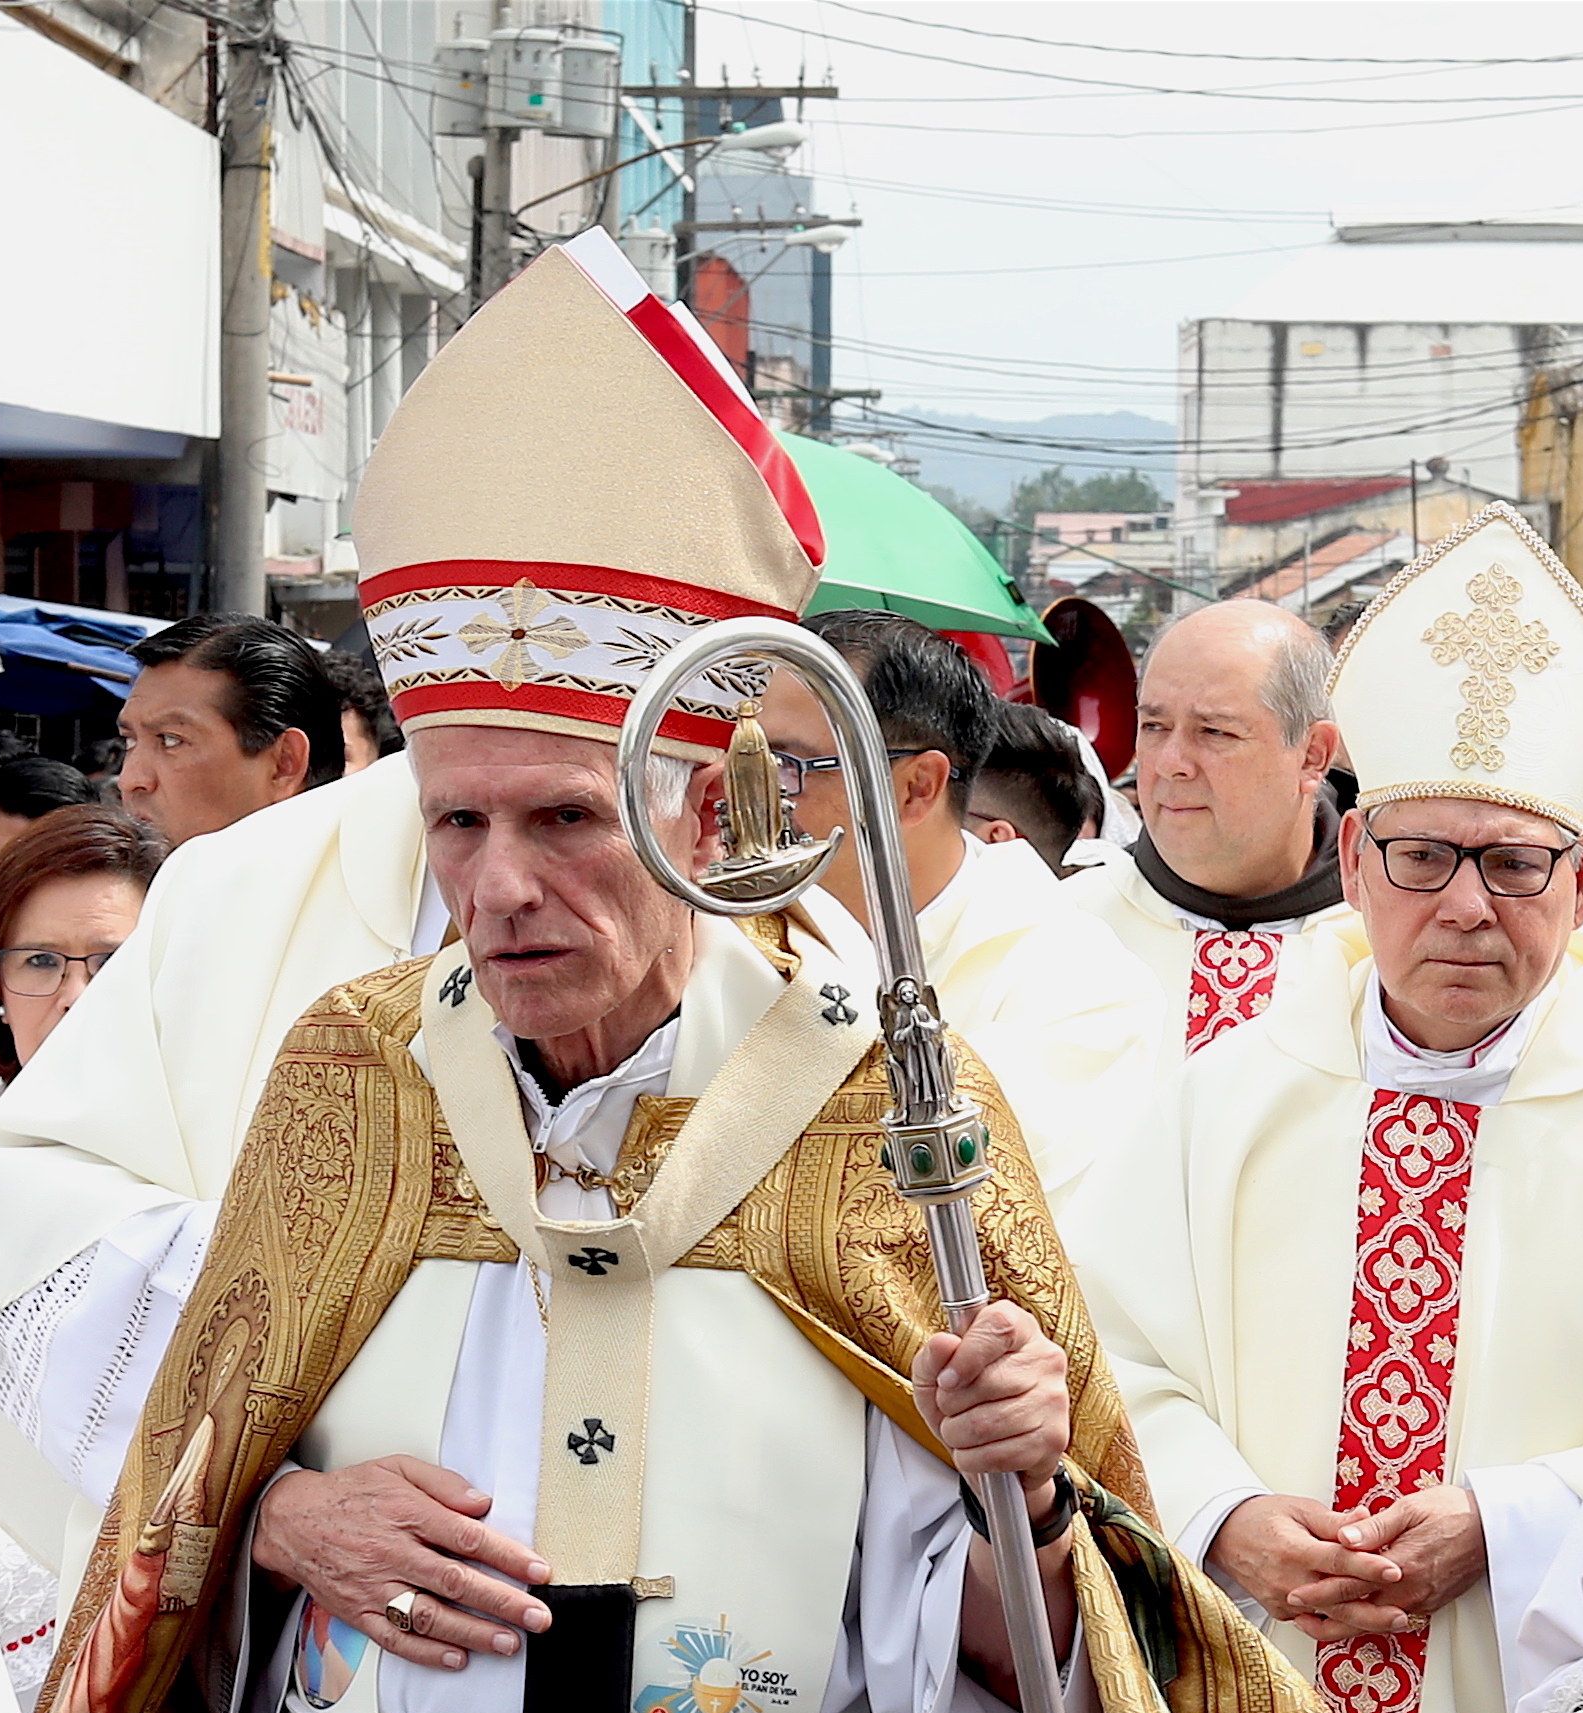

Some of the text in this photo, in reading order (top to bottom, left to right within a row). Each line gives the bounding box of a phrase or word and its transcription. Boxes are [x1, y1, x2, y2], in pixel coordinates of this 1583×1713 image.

[740, 1667, 759, 1682] YO
[761, 1671, 789, 1686] SOY
[741, 1683, 798, 1697] EL PAN DE VIDA
